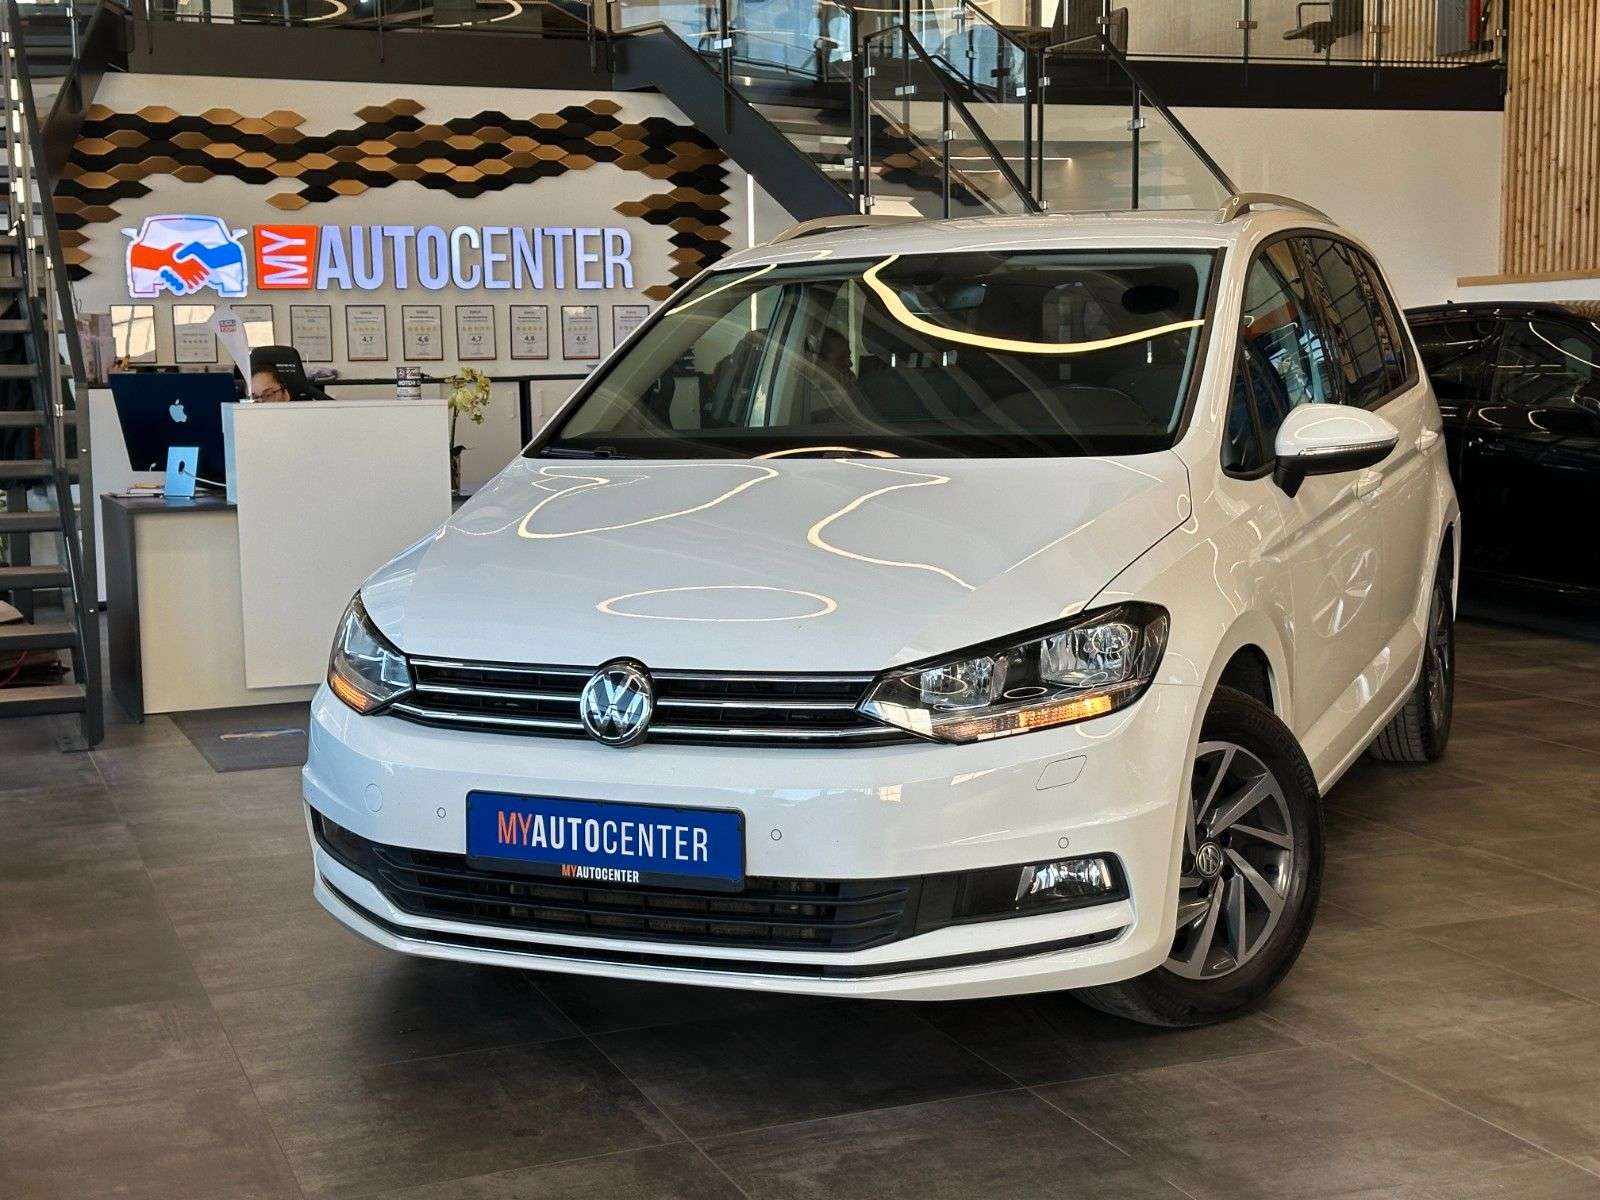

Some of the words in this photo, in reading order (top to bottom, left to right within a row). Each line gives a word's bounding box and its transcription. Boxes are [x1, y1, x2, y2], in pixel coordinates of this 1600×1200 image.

[260, 229, 309, 285] MY
[316, 224, 634, 290] AUTOCENTER
[497, 810, 709, 863] MYAUTOCENTER
[561, 863, 640, 884] MYAUTOCENTER
